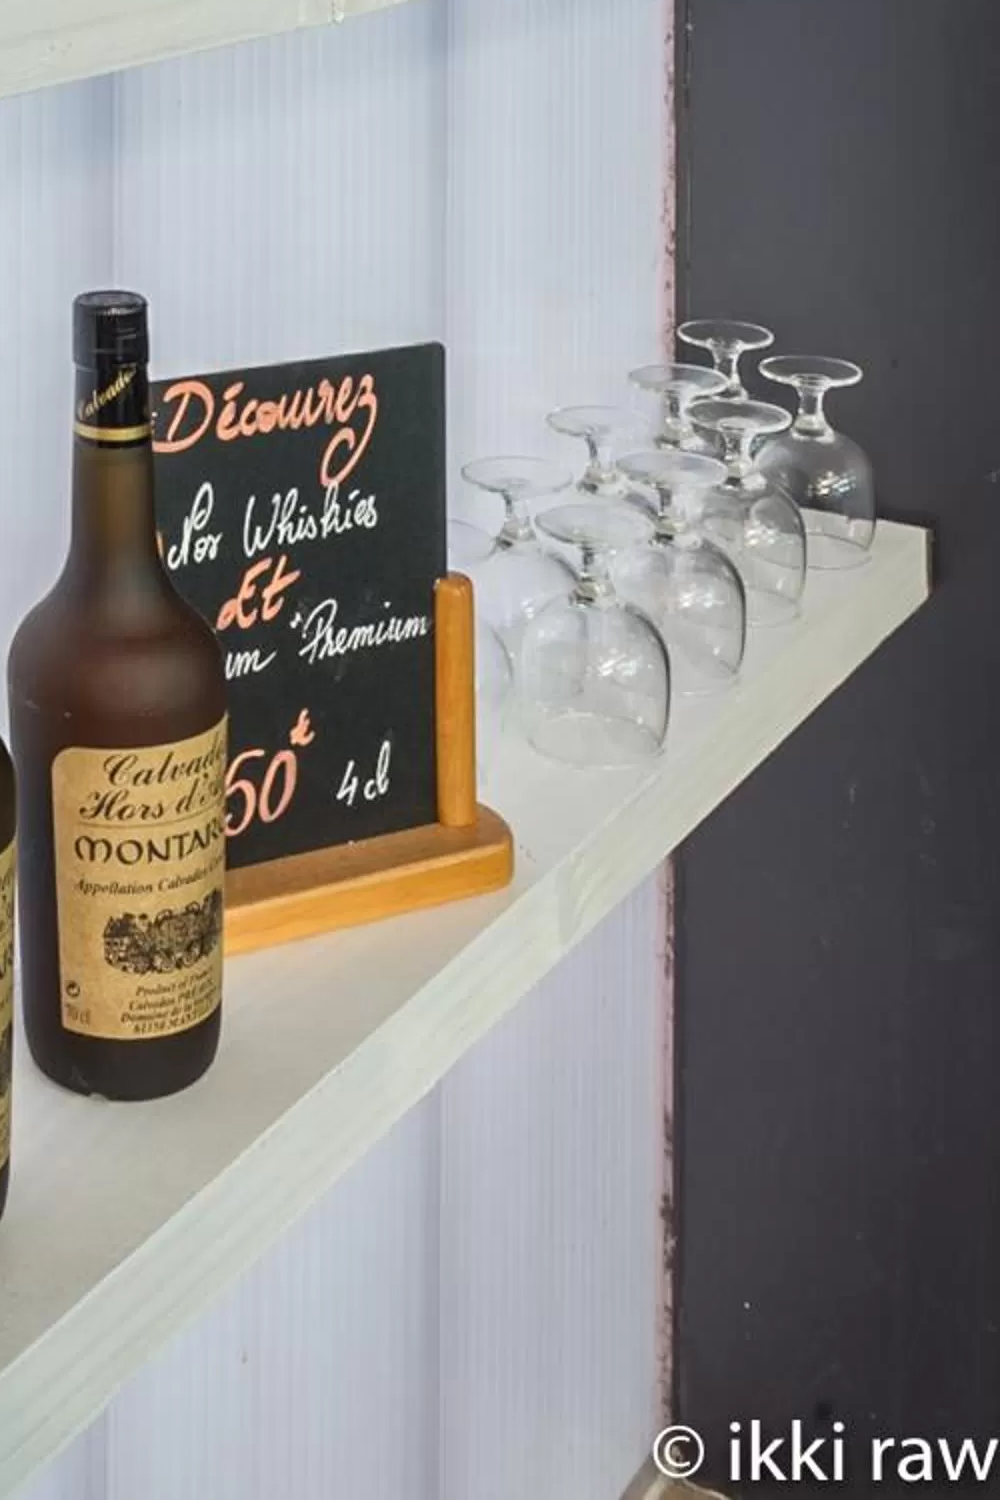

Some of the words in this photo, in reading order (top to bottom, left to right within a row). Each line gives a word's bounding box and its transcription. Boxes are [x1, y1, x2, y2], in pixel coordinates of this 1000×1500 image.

[243, 480, 379, 558] Whiskies
[290, 598, 428, 665] Premium
[79, 789, 165, 821] Hors
[75, 877, 154, 897] Appellation
